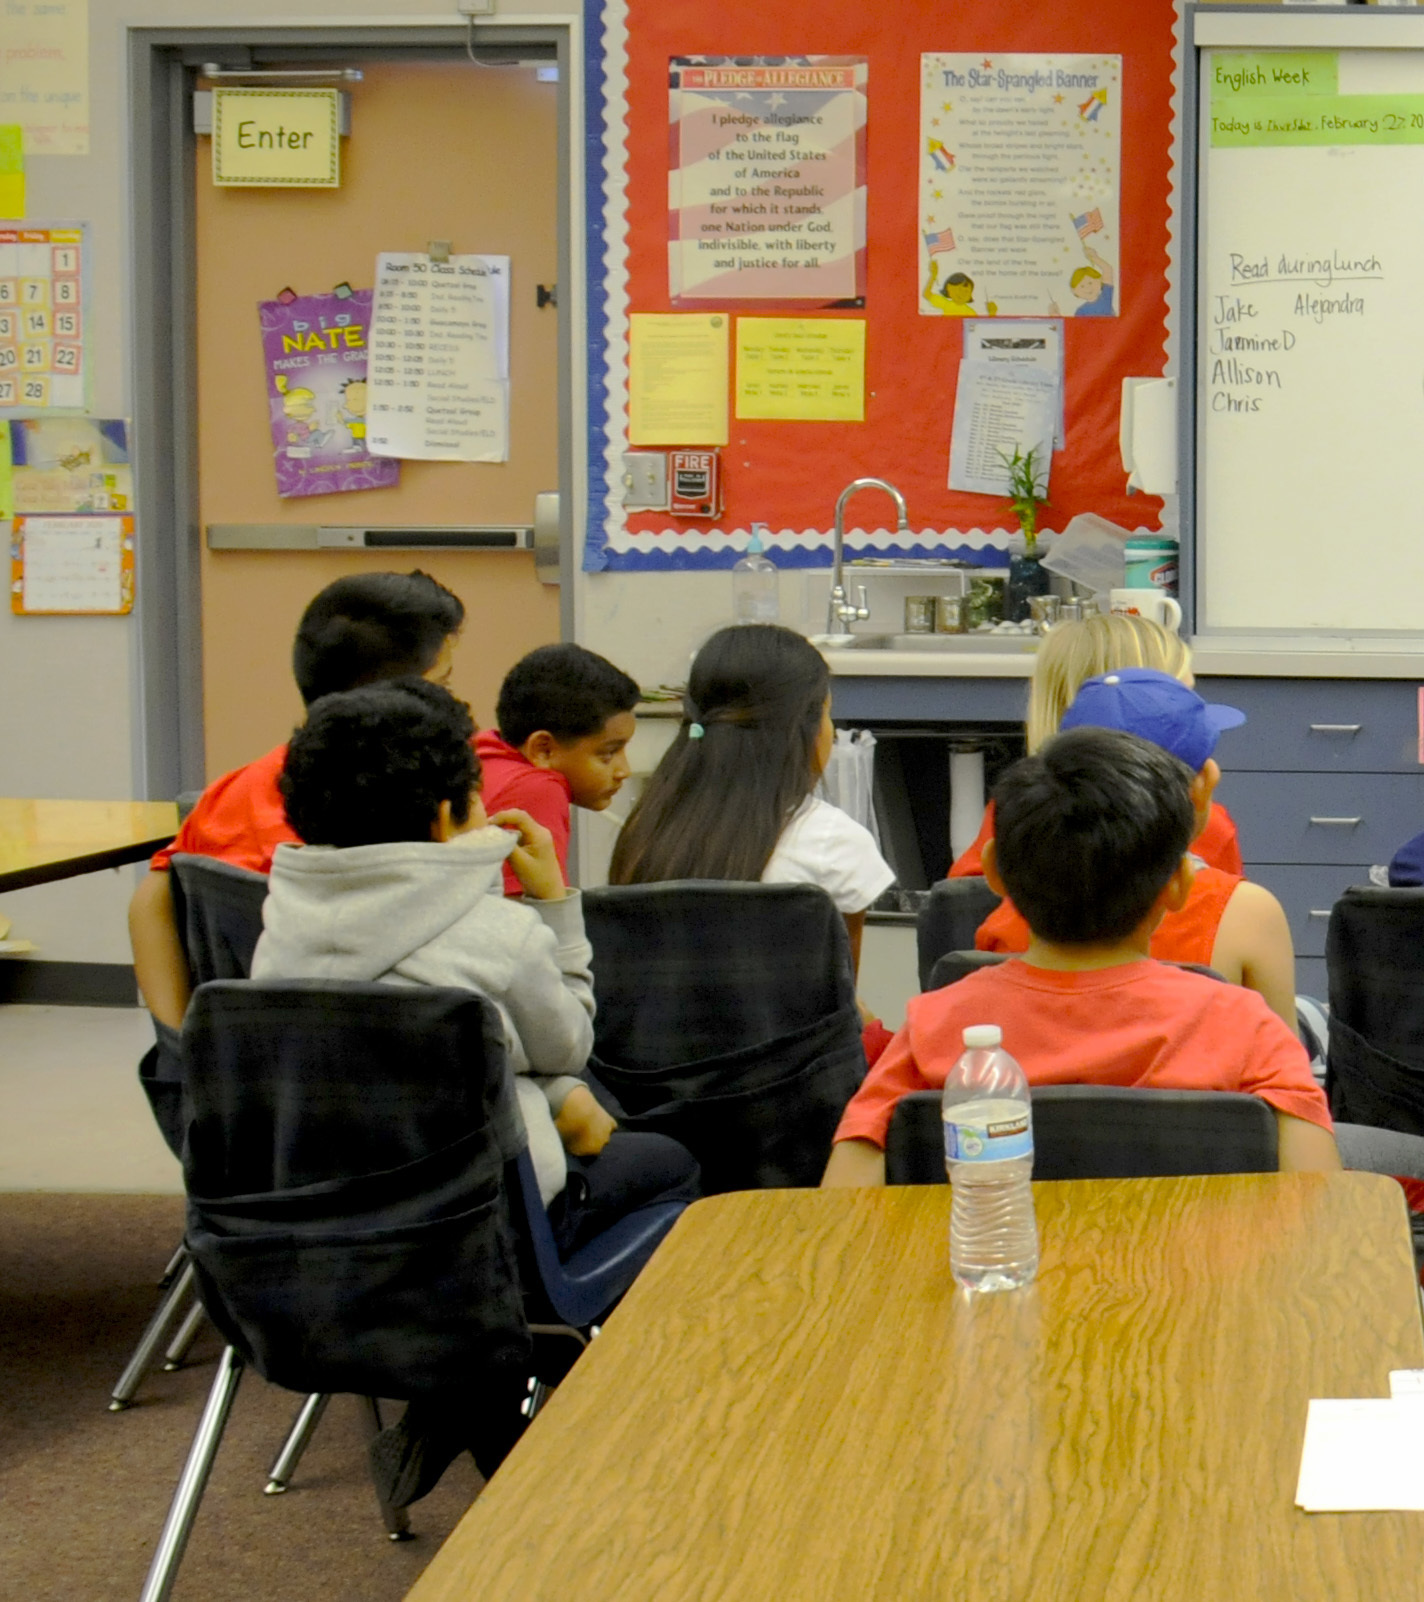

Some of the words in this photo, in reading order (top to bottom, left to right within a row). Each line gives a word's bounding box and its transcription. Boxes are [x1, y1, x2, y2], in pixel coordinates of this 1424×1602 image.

[704, 70, 755, 86] PLEDGE
[761, 71, 844, 87] ALLEGIANCE
[943, 70, 965, 88] The
[968, 68, 1052, 94] Star-Spangled
[1056, 69, 1099, 88] Banner
[1216, 65, 1266, 92] English
[1272, 68, 1310, 87] Week
[713, 114, 717, 124] I
[720, 114, 760, 127] pledge
[764, 113, 823, 127] allegiance
[1212, 117, 1250, 135] Today
[1253, 120, 1262, 131] is
[1321, 115, 1379, 133] February
[238, 120, 314, 149] Enter
[736, 132, 748, 143] to
[752, 131, 772, 143] the
[776, 131, 799, 146] flag
[708, 149, 720, 161] of
[726, 149, 745, 161] the
[748, 149, 786, 161] United
[790, 149, 827, 161] States
[734, 167, 747, 179] of
[752, 167, 800, 179] America
[710, 185, 731, 196] and
[735, 186, 747, 196] to
[751, 185, 770, 196] the
[774, 185, 824, 199] Republic
[710, 203, 727, 214] for
[732, 203, 767, 214] which
[770, 203, 779, 214] it
[701, 223, 722, 232] one
[726, 222, 765, 232] Nation
[768, 222, 803, 232] under
[765, 239, 793, 250] with
[796, 239, 836, 253] liberty
[62, 253, 69, 267] 1
[714, 257, 735, 268] and
[739, 257, 778, 271] justice
[782, 257, 799, 268] for
[1230, 253, 1269, 281] Read
[386, 262, 410, 273] Room
[413, 263, 427, 273] 50
[430, 263, 455, 274] Class
[29, 285, 38, 299] 7
[60, 285, 70, 299] 8
[1214, 295, 1259, 325] Jake
[1294, 292, 1364, 324] Alejandra
[29, 315, 45, 330] 14
[59, 316, 74, 331] 15
[293, 314, 351, 332] big
[282, 325, 365, 353] NATE
[26, 350, 41, 364] 21
[56, 351, 75, 365] 22
[273, 355, 311, 370] MAKES
[318, 353, 337, 365] THE
[1212, 357, 1282, 389] Allison
[25, 383, 43, 398] 28
[1212, 391, 1263, 413] Chris
[675, 455, 710, 469] FIRE
